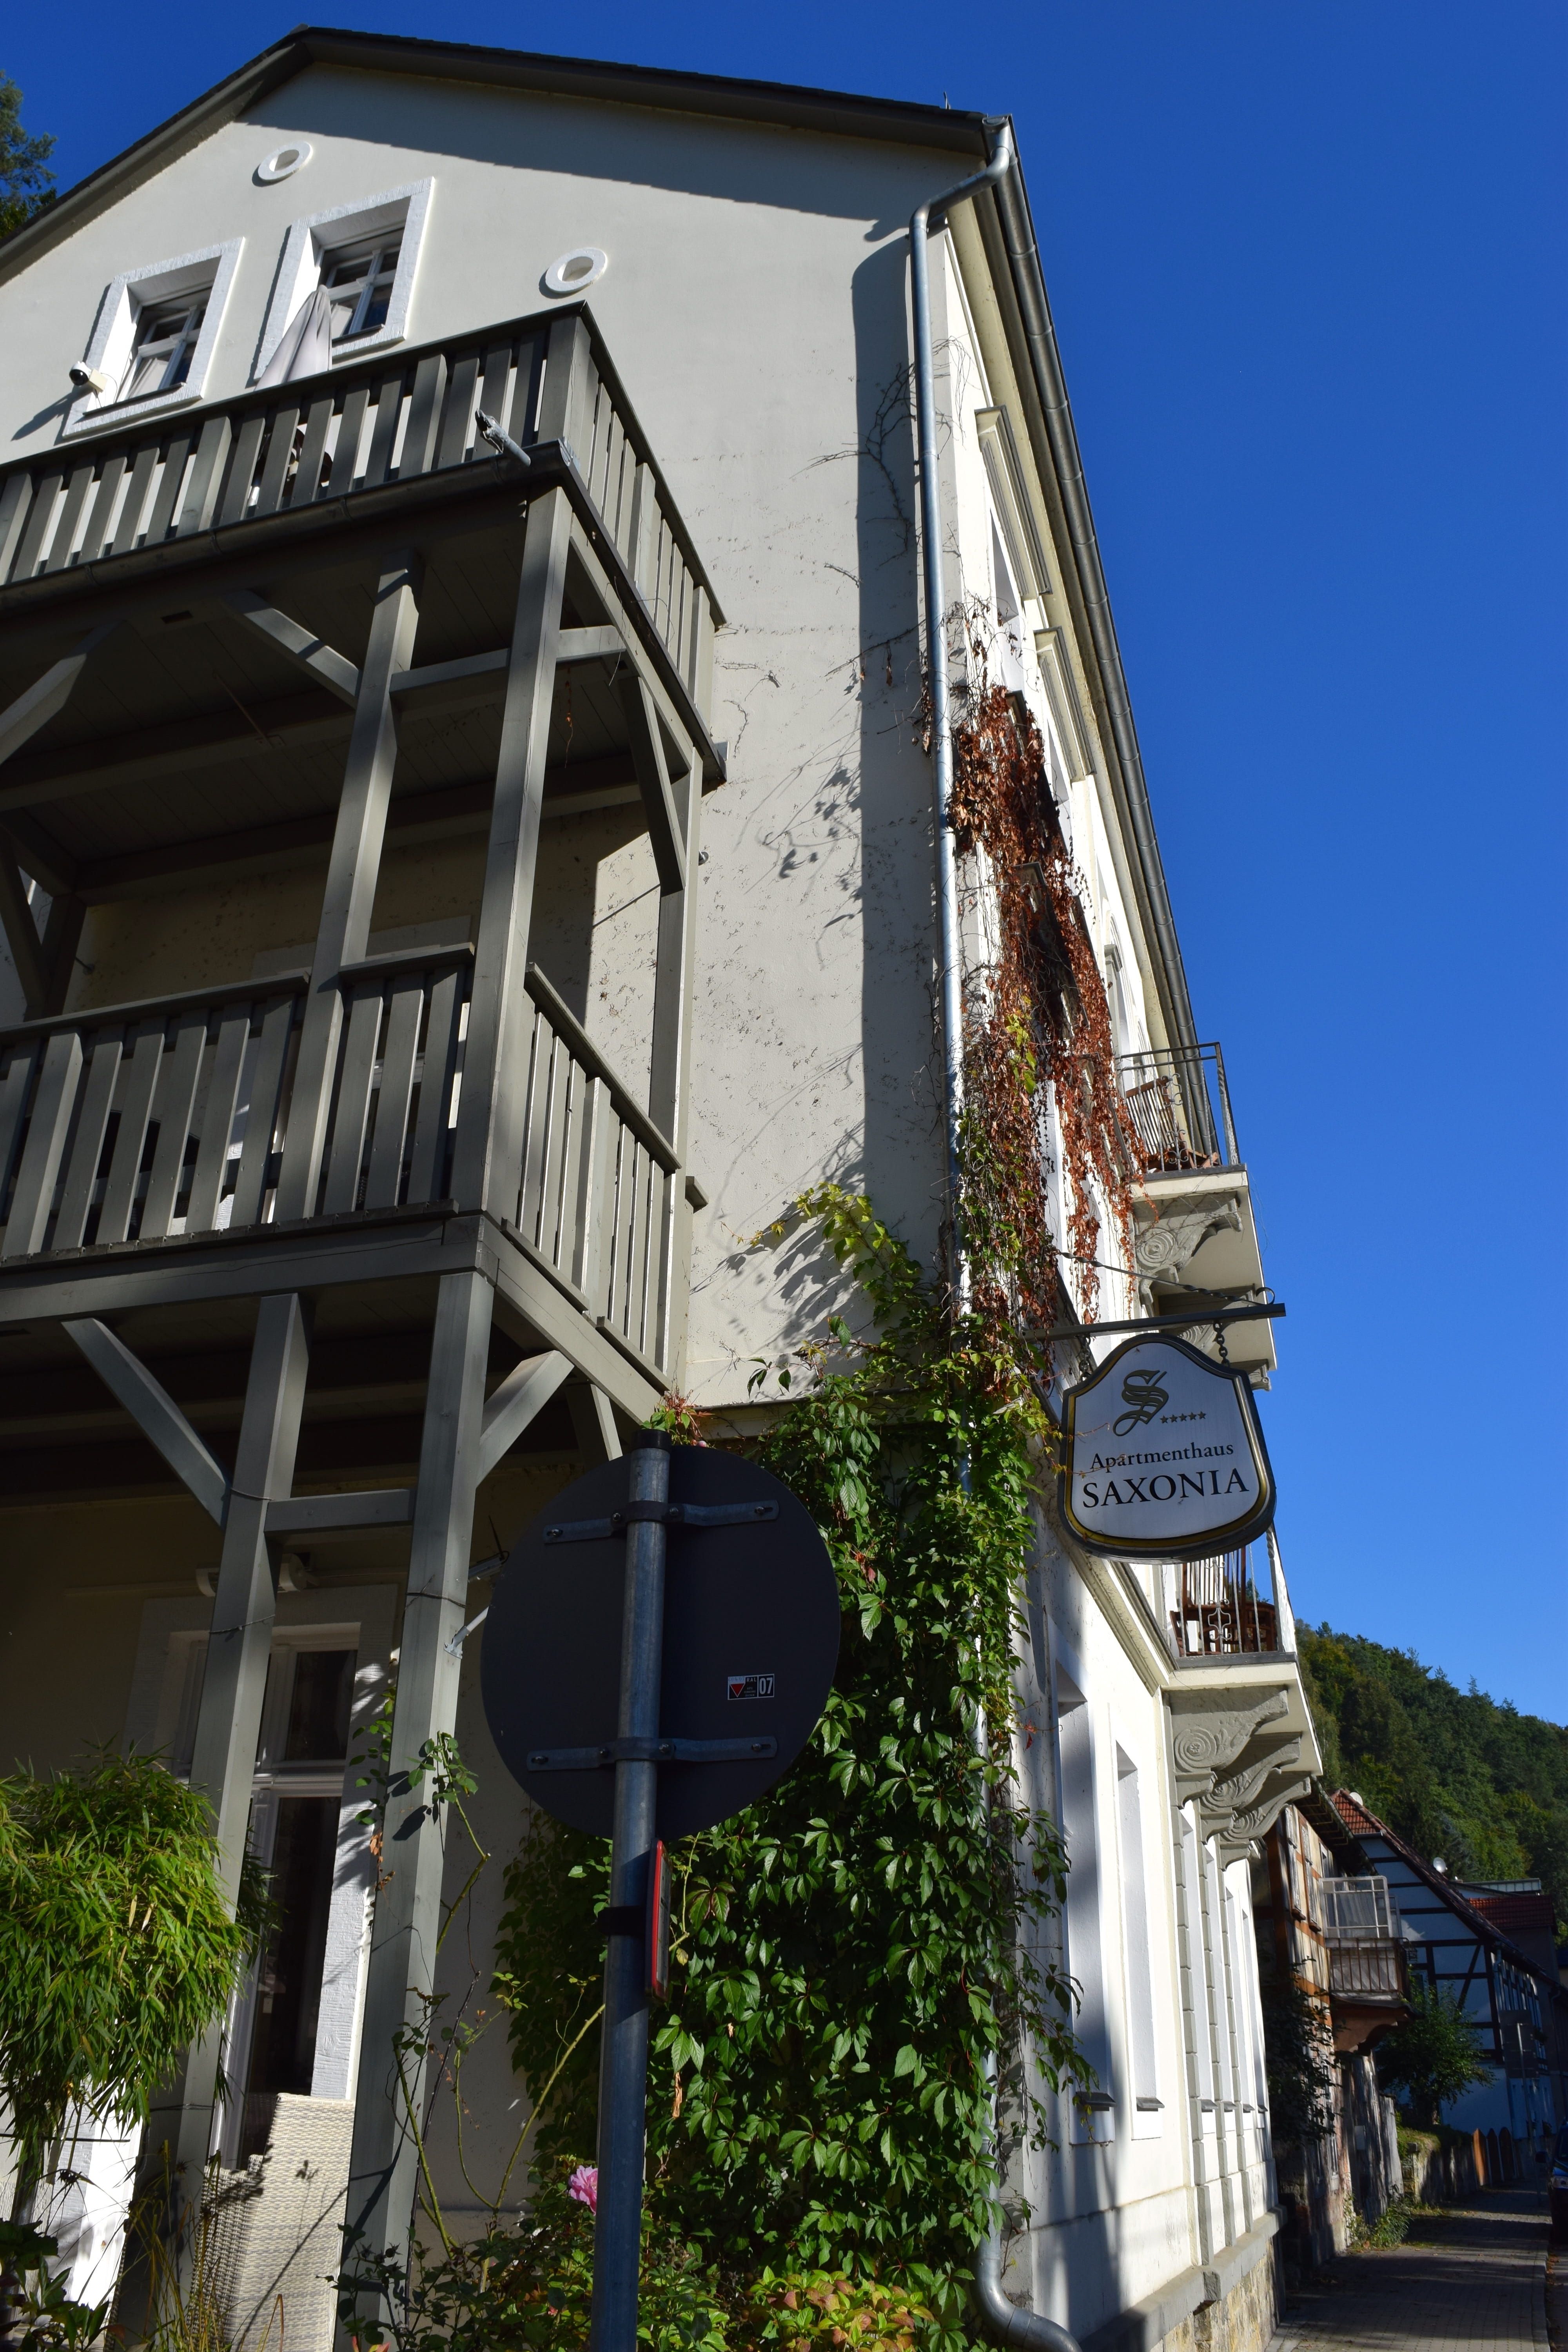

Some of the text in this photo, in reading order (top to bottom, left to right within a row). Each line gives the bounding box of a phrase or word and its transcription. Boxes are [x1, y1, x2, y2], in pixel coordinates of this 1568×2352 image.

[1089, 1442, 1234, 1474] Apartmenthaus
[1082, 1468, 1250, 1508] SAXONIA
[759, 1677, 773, 1694] 07
